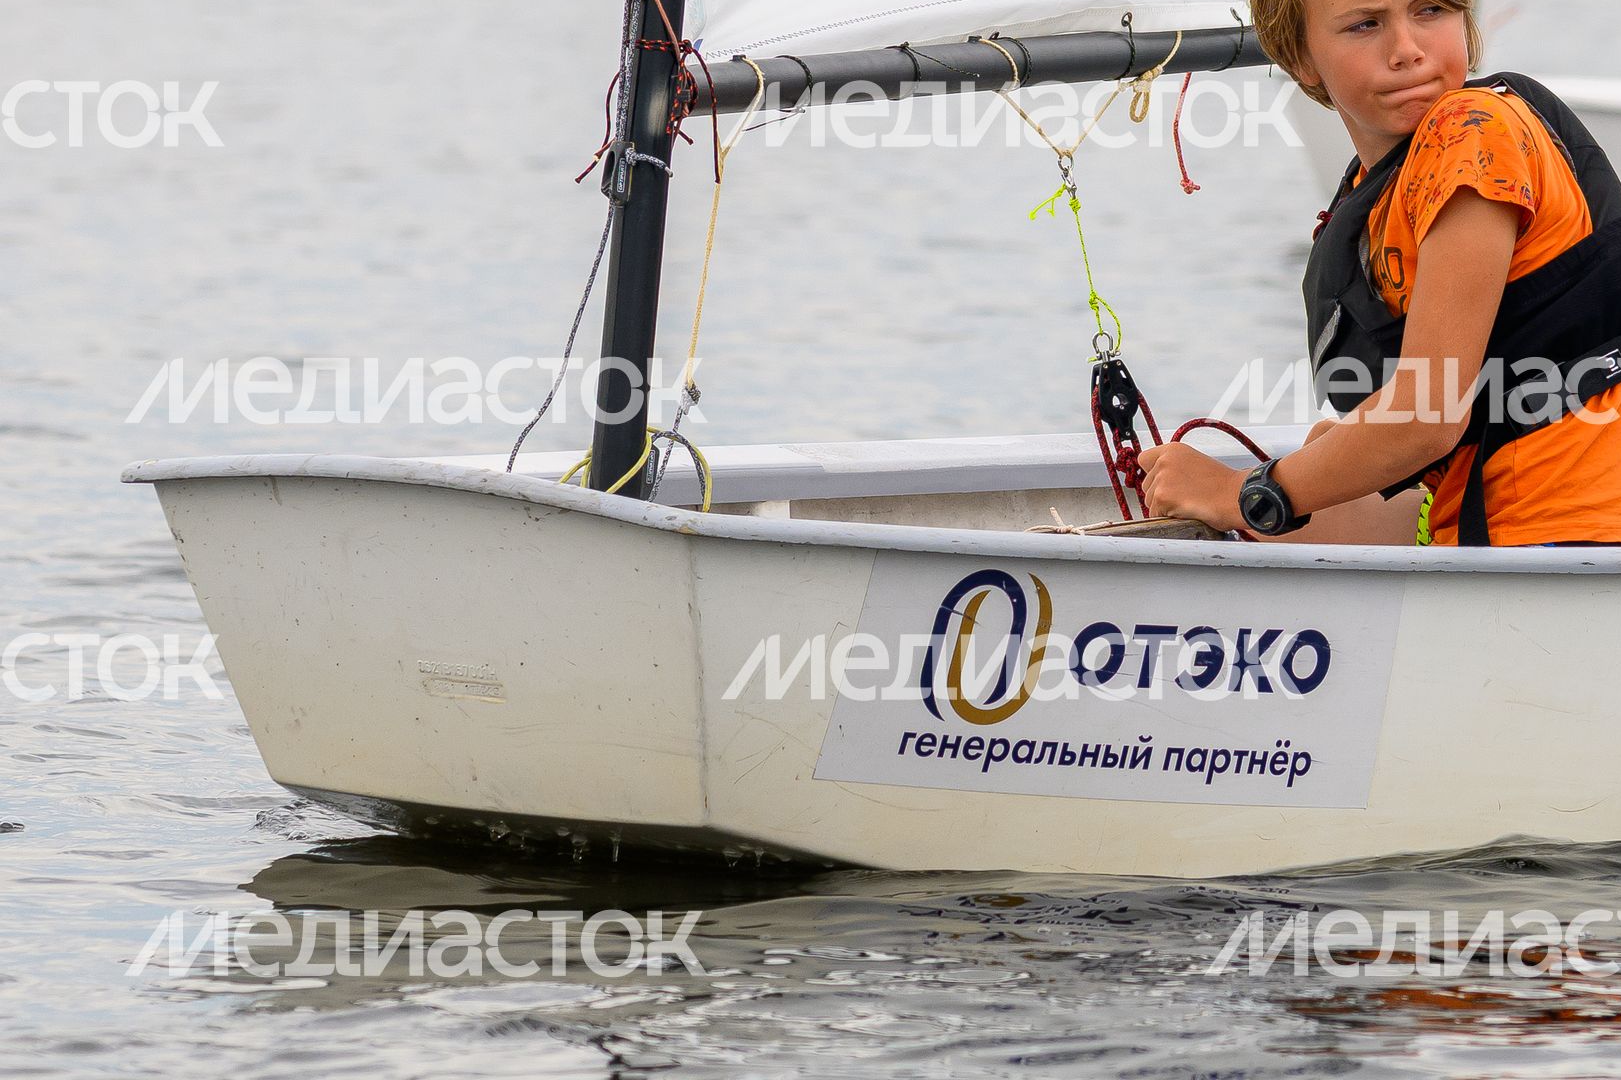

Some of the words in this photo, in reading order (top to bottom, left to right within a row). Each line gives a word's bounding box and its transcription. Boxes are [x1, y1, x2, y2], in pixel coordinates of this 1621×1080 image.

[1069, 620, 1331, 696] ОТЭКО
[897, 728, 1153, 773] генеральный
[1162, 737, 1312, 789] партнёр
